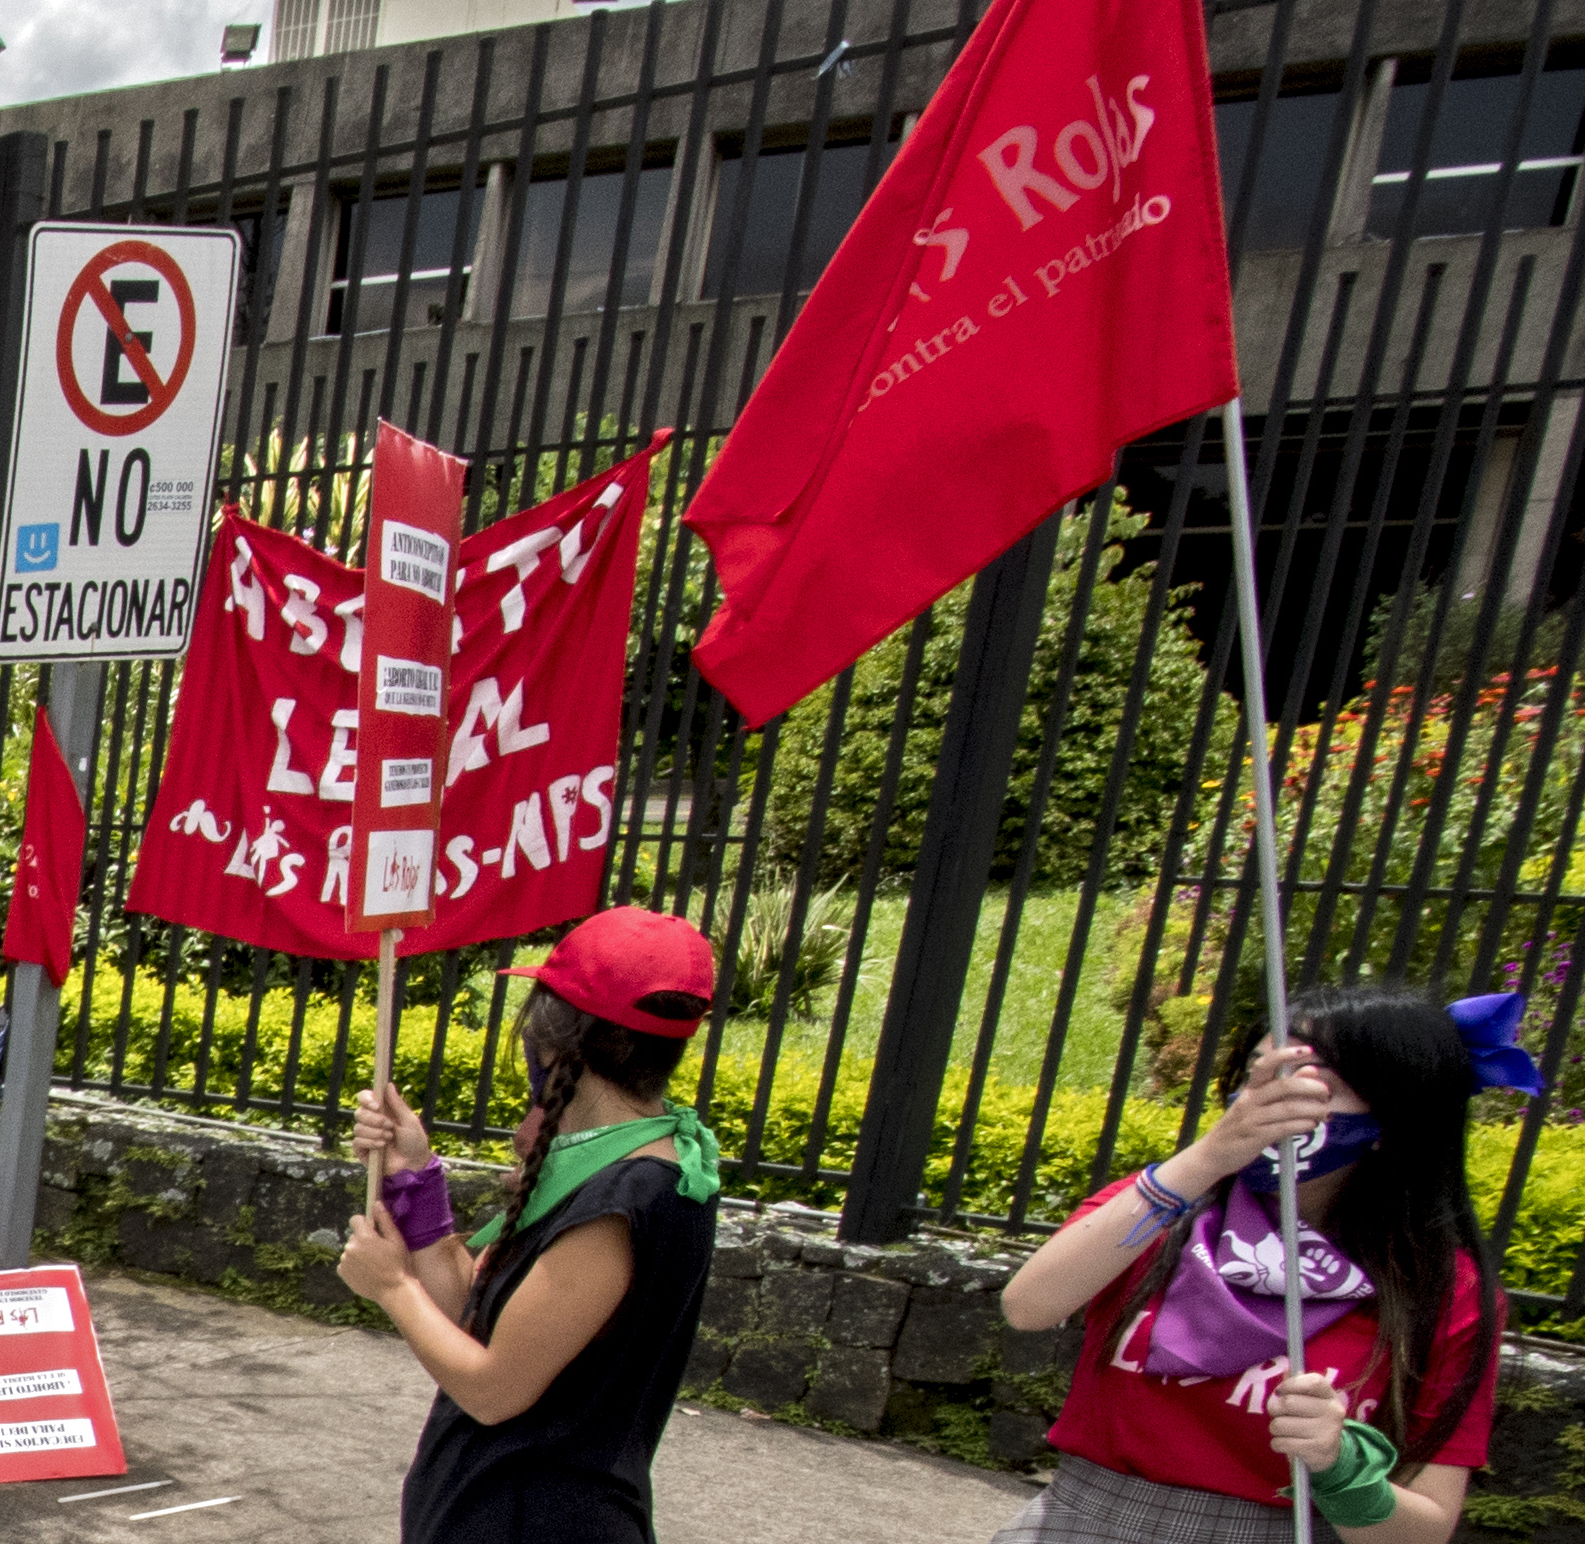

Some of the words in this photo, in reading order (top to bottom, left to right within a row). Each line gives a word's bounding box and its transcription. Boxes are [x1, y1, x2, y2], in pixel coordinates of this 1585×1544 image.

[987, 275, 1030, 318] el
[69, 448, 151, 547] NO
[0, 578, 190, 643] ESTACIONAR
[266, 676, 550, 802] LEAL
[31, 1424, 65, 1434] PARA
